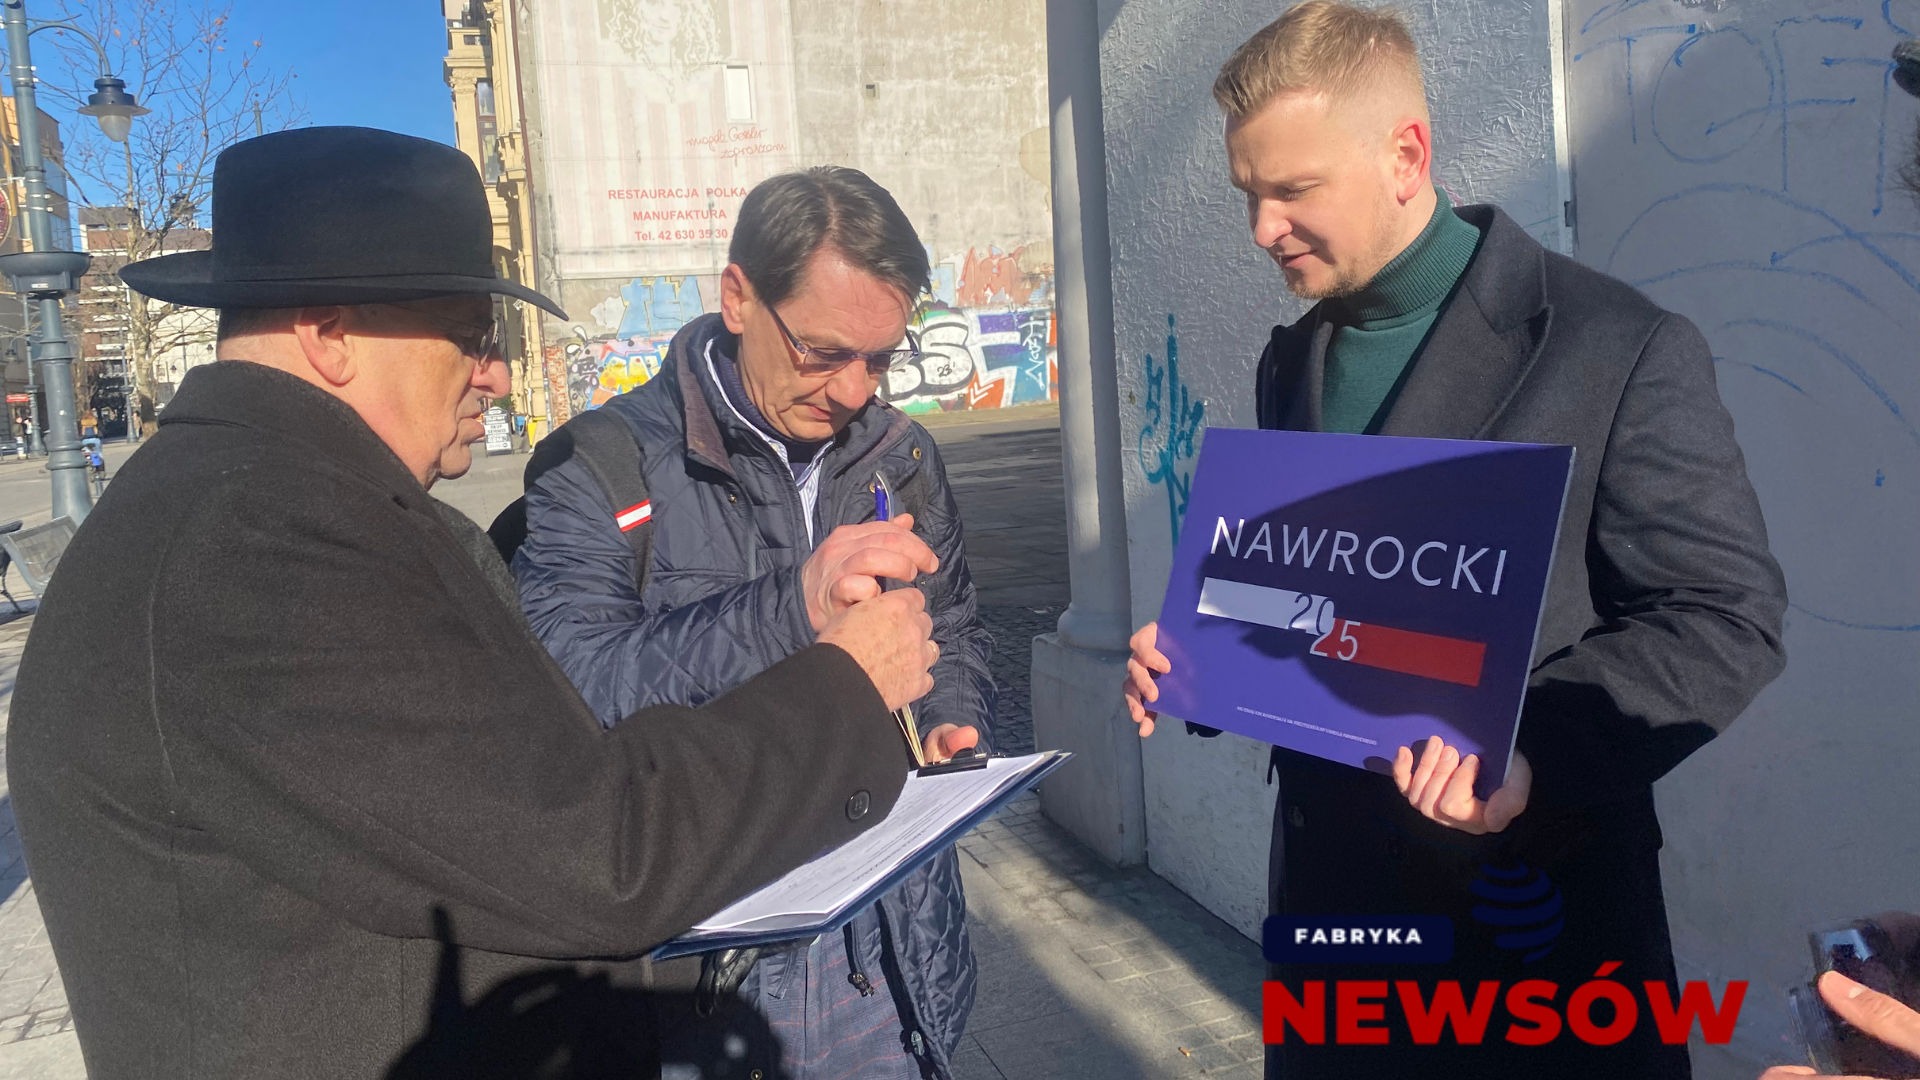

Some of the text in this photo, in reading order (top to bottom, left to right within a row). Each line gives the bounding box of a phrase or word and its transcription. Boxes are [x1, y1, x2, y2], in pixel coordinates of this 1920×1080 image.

[608, 187, 747, 200] RESTAURACJA POLKA
[633, 209, 727, 221] MANUFAKTURA
[635, 229, 728, 241] Tel. 42 630 35 30
[1210, 516, 1507, 596] NAWROCKI
